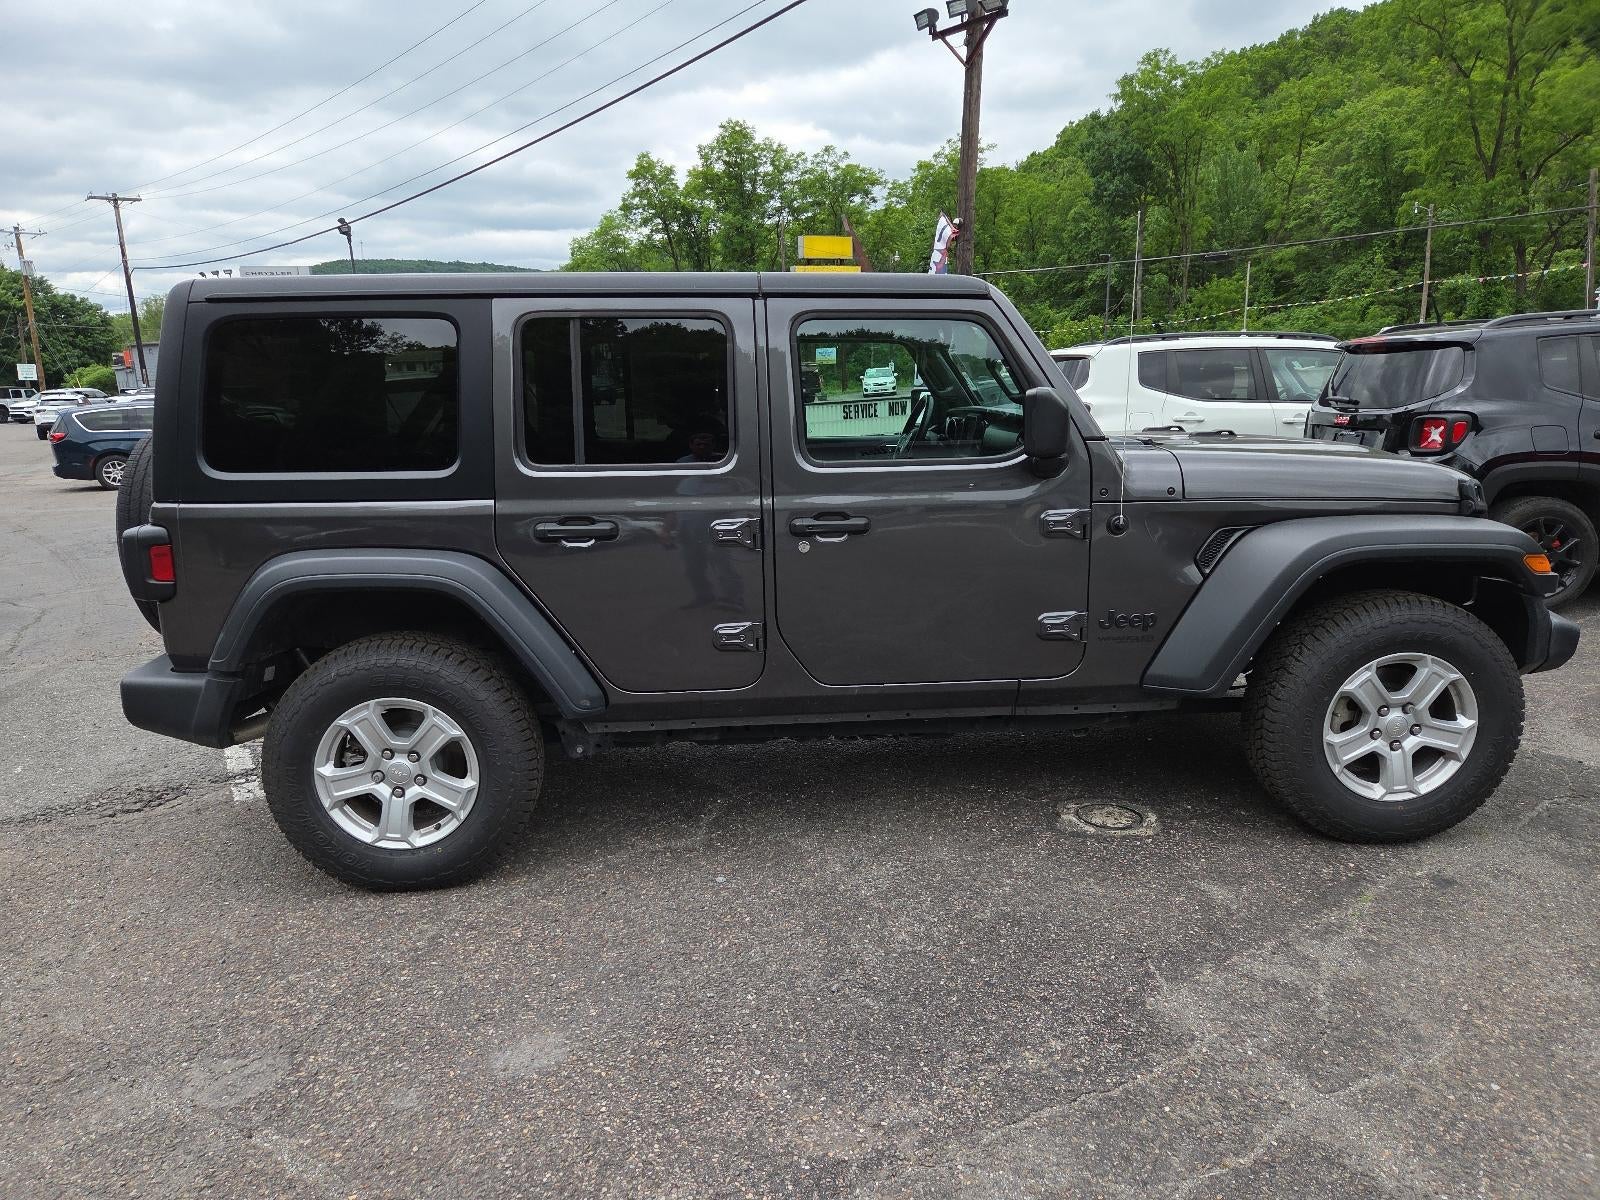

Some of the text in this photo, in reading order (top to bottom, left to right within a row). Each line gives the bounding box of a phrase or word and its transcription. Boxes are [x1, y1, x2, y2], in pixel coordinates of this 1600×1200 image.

[843, 401, 908, 420] SERVICE NOW
[1098, 608, 1157, 631] Jeep
